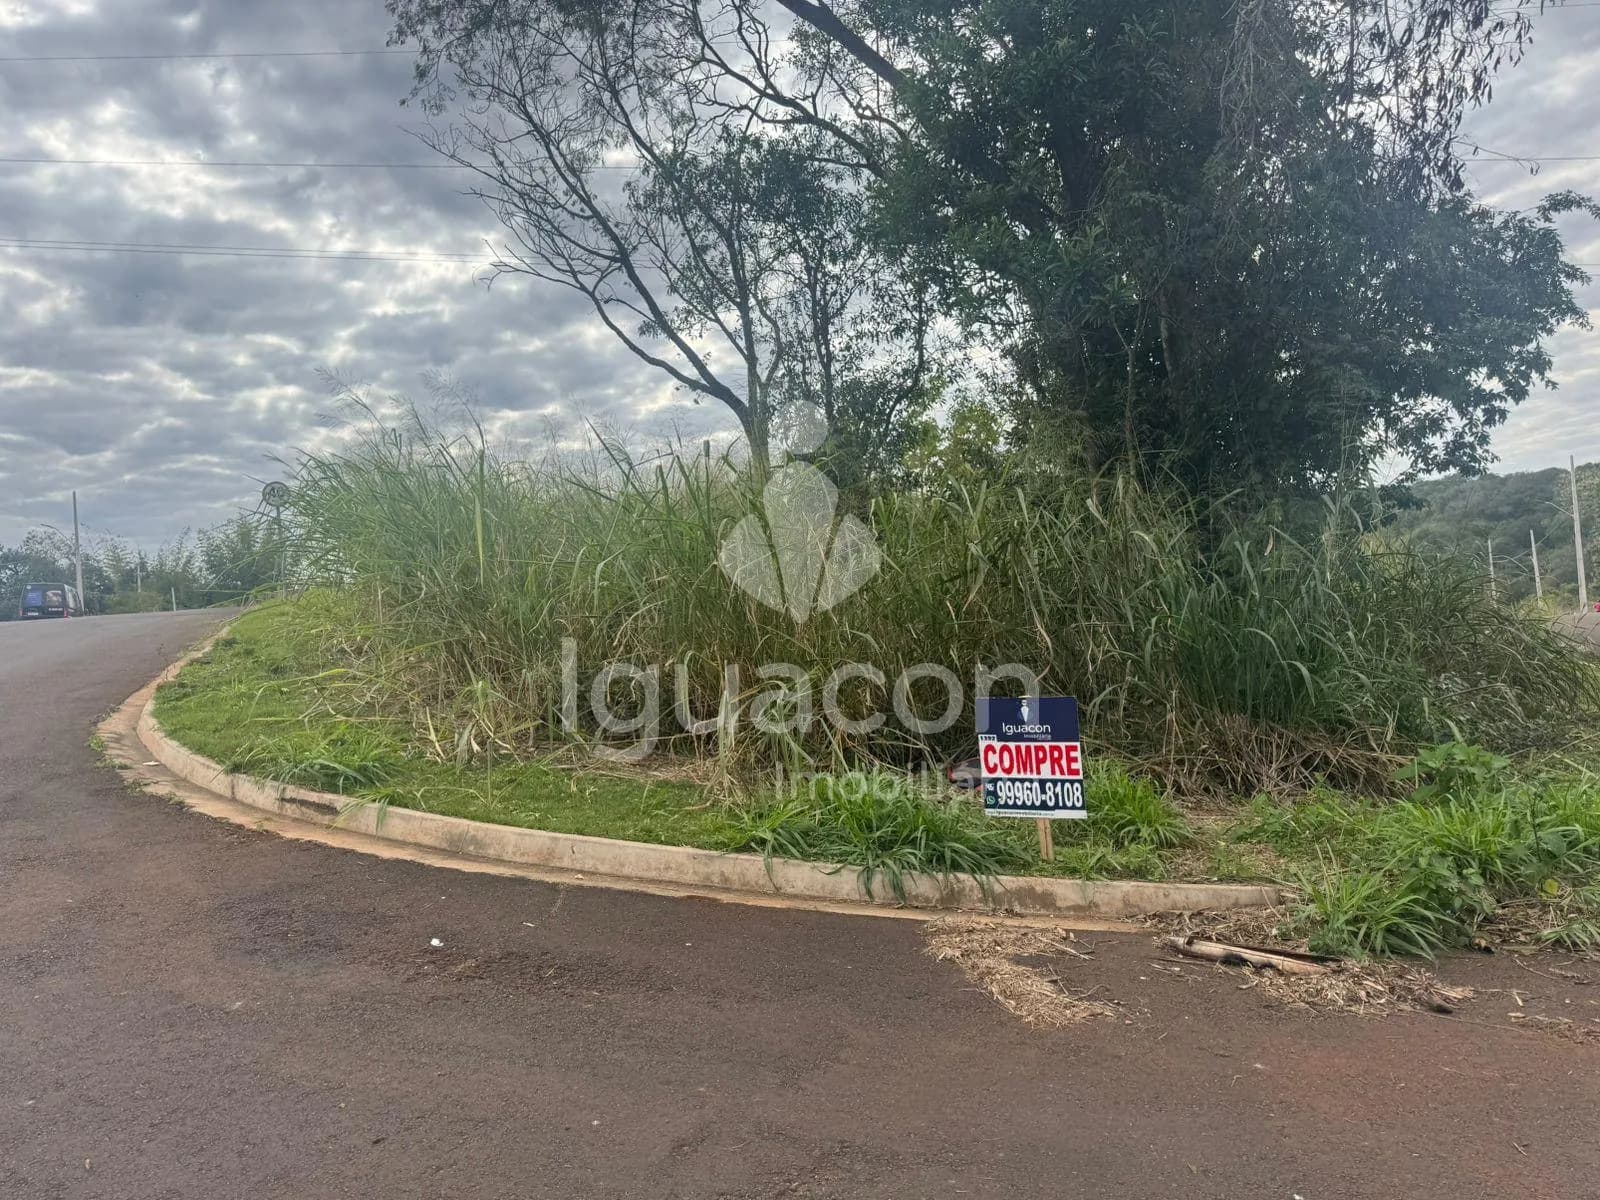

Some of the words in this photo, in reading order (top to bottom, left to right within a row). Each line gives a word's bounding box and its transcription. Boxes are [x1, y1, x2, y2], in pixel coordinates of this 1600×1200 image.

[1002, 722, 1051, 736] Iguacon
[983, 743, 1081, 777] COMPRE
[996, 780, 1083, 808] 99960-8108
